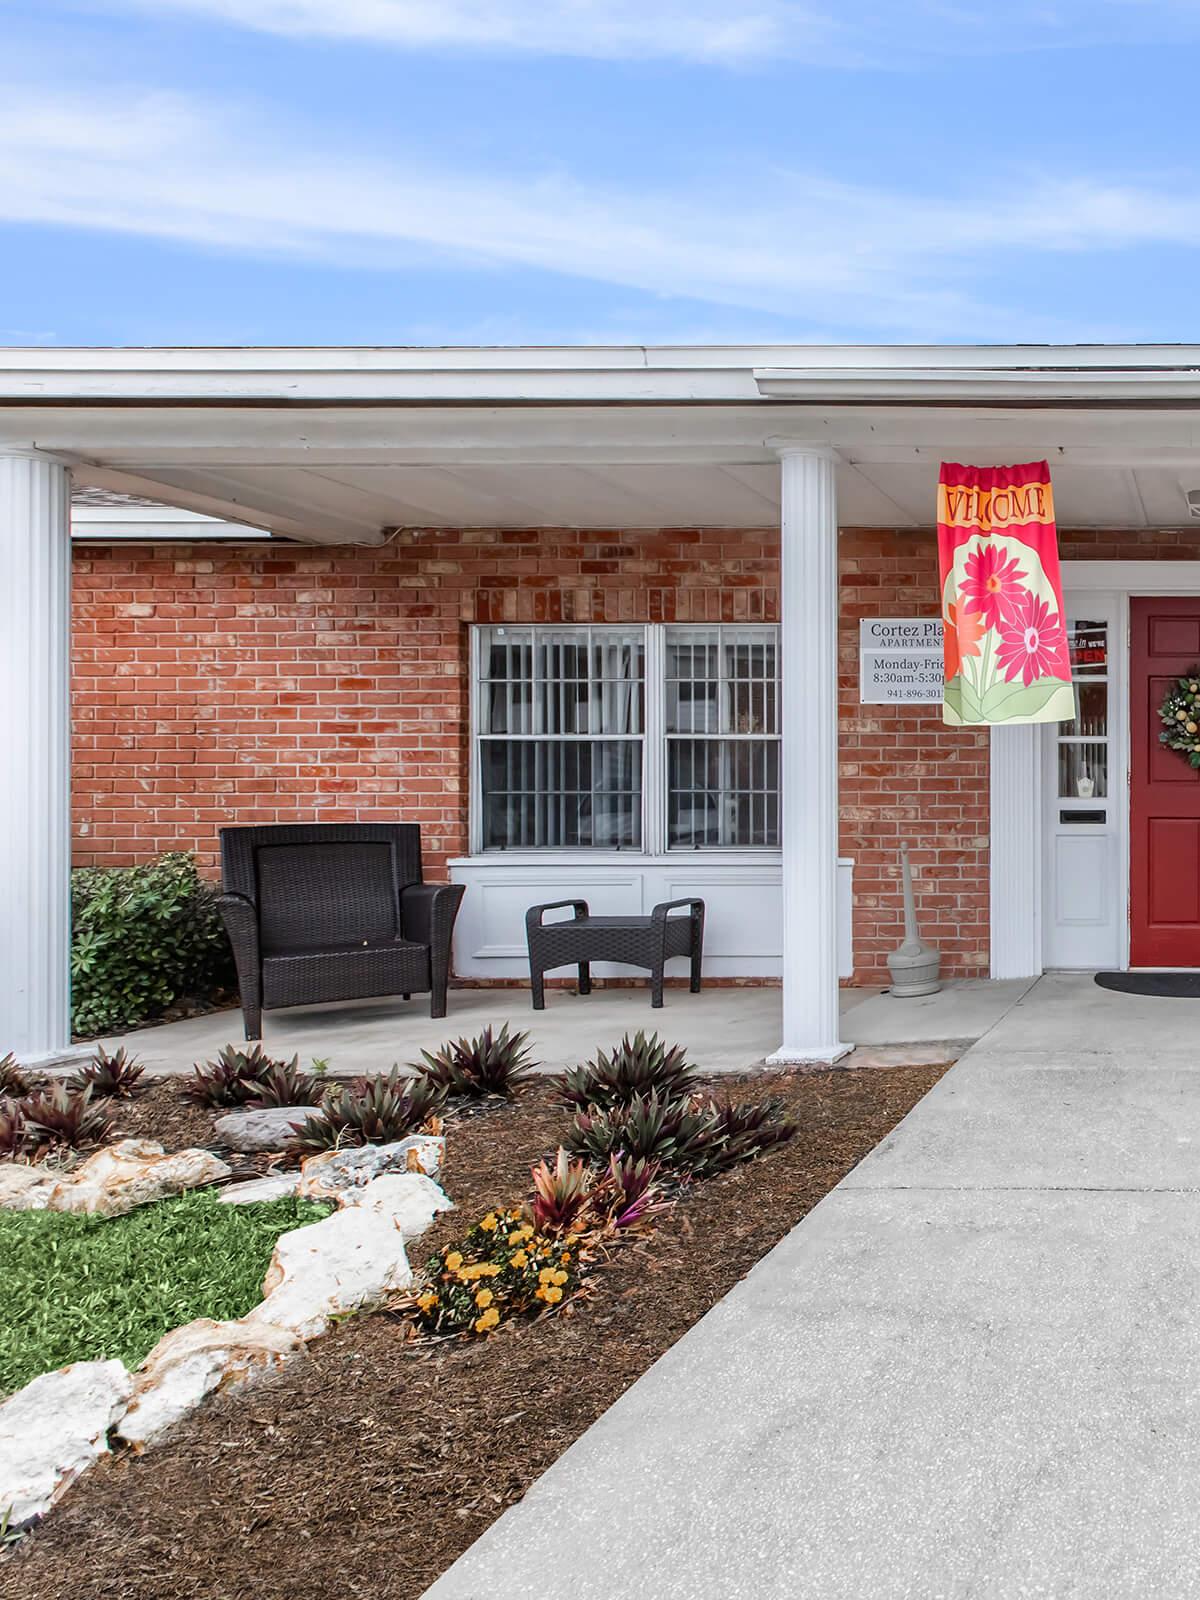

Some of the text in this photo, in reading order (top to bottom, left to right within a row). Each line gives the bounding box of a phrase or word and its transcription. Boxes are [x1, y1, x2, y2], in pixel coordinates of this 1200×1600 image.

[871, 623, 919, 637] Cortez
[879, 638, 945, 647] APARTMEN
[887, 689, 945, 698] 941-896-301
